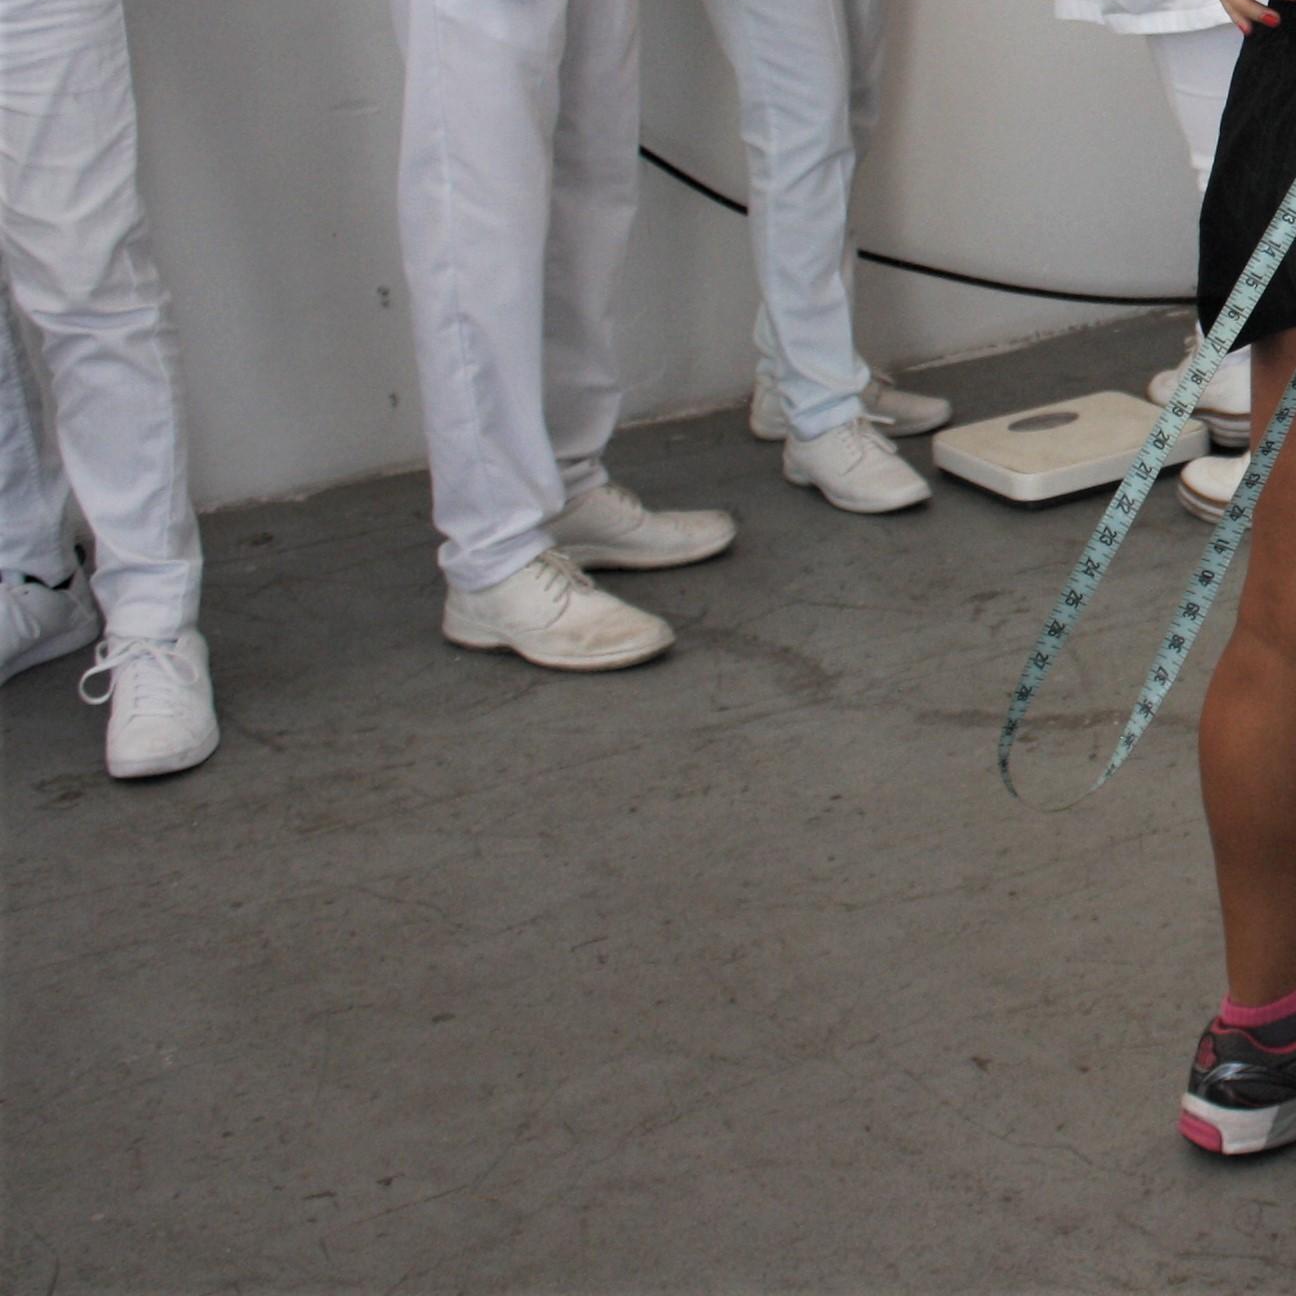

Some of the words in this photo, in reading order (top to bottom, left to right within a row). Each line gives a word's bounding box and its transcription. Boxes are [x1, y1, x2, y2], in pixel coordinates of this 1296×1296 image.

[1262, 241, 1281, 258] 14
[1246, 273, 1262, 289] 15
[1228, 305, 1244, 321] 16
[1210, 337, 1226, 353] 17
[1191, 368, 1206, 384] 18
[1172, 400, 1188, 417] 19
[1151, 429, 1170, 450] 20
[1136, 462, 1152, 480] 21
[1116, 493, 1134, 514] 22
[1100, 527, 1117, 546] 23
[1083, 558, 1100, 577] 24
